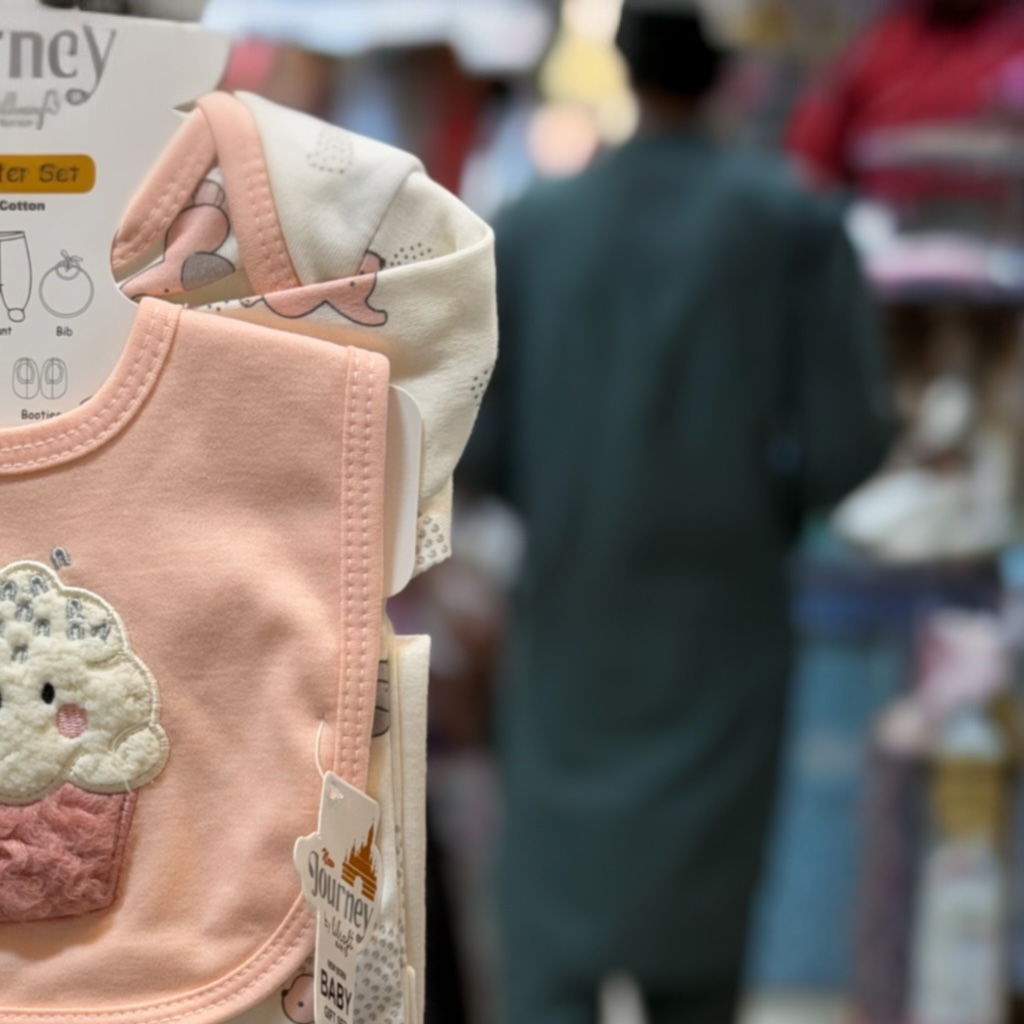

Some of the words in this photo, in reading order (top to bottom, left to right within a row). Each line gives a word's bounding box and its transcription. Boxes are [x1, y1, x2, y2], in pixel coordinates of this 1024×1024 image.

[39, 163, 80, 183] Set
[56, 326, 73, 337] Bib
[308, 850, 374, 944] Journey
[320, 968, 352, 1016] BABY
